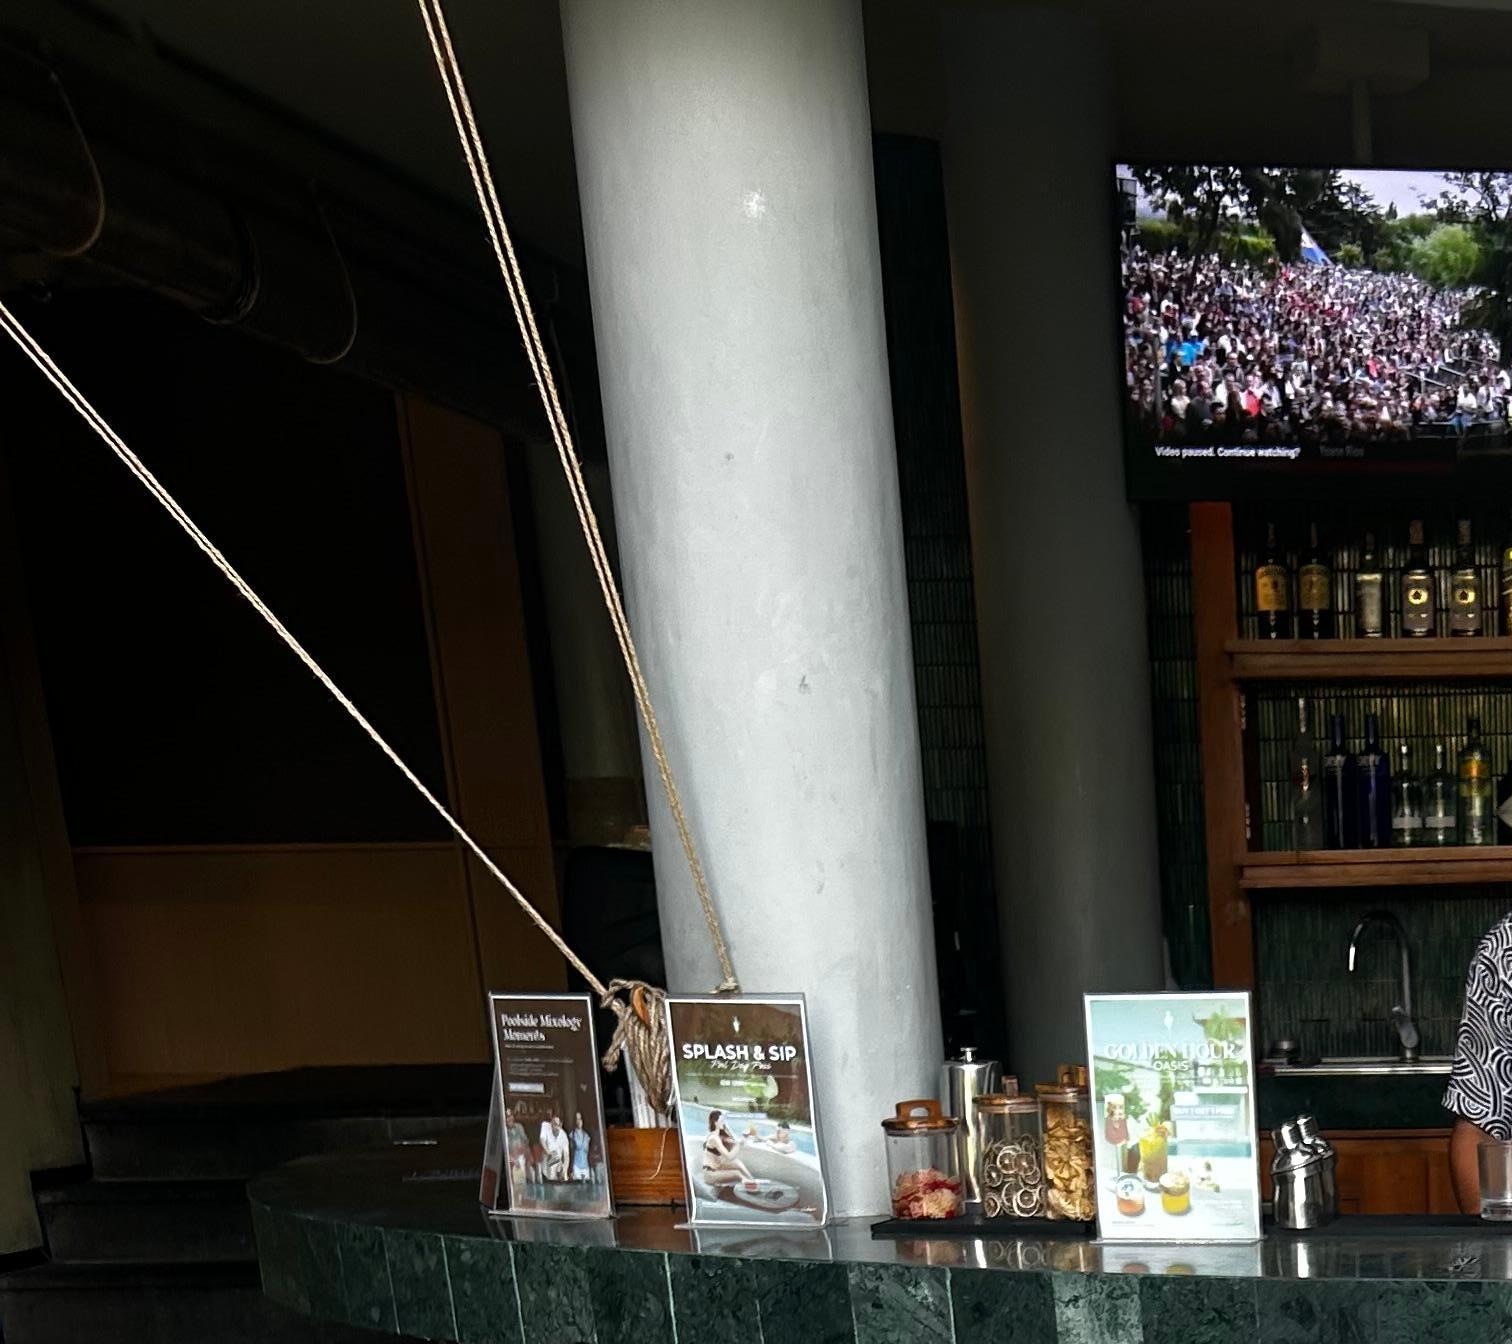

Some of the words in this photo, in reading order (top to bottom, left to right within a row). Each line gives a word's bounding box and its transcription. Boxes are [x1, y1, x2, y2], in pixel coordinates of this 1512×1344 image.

[1154, 446, 1180, 457] Video
[1217, 447, 1255, 457] Continue
[1257, 446, 1301, 459] watching?
[501, 1013, 538, 1027] Poolside
[540, 1013, 582, 1032] Mixology
[503, 1028, 545, 1042] Moments
[682, 1043, 749, 1060] SPLASH
[753, 1045, 766, 1061] &
[768, 1045, 797, 1061] SIP
[1153, 1060, 1189, 1071] OASIS
